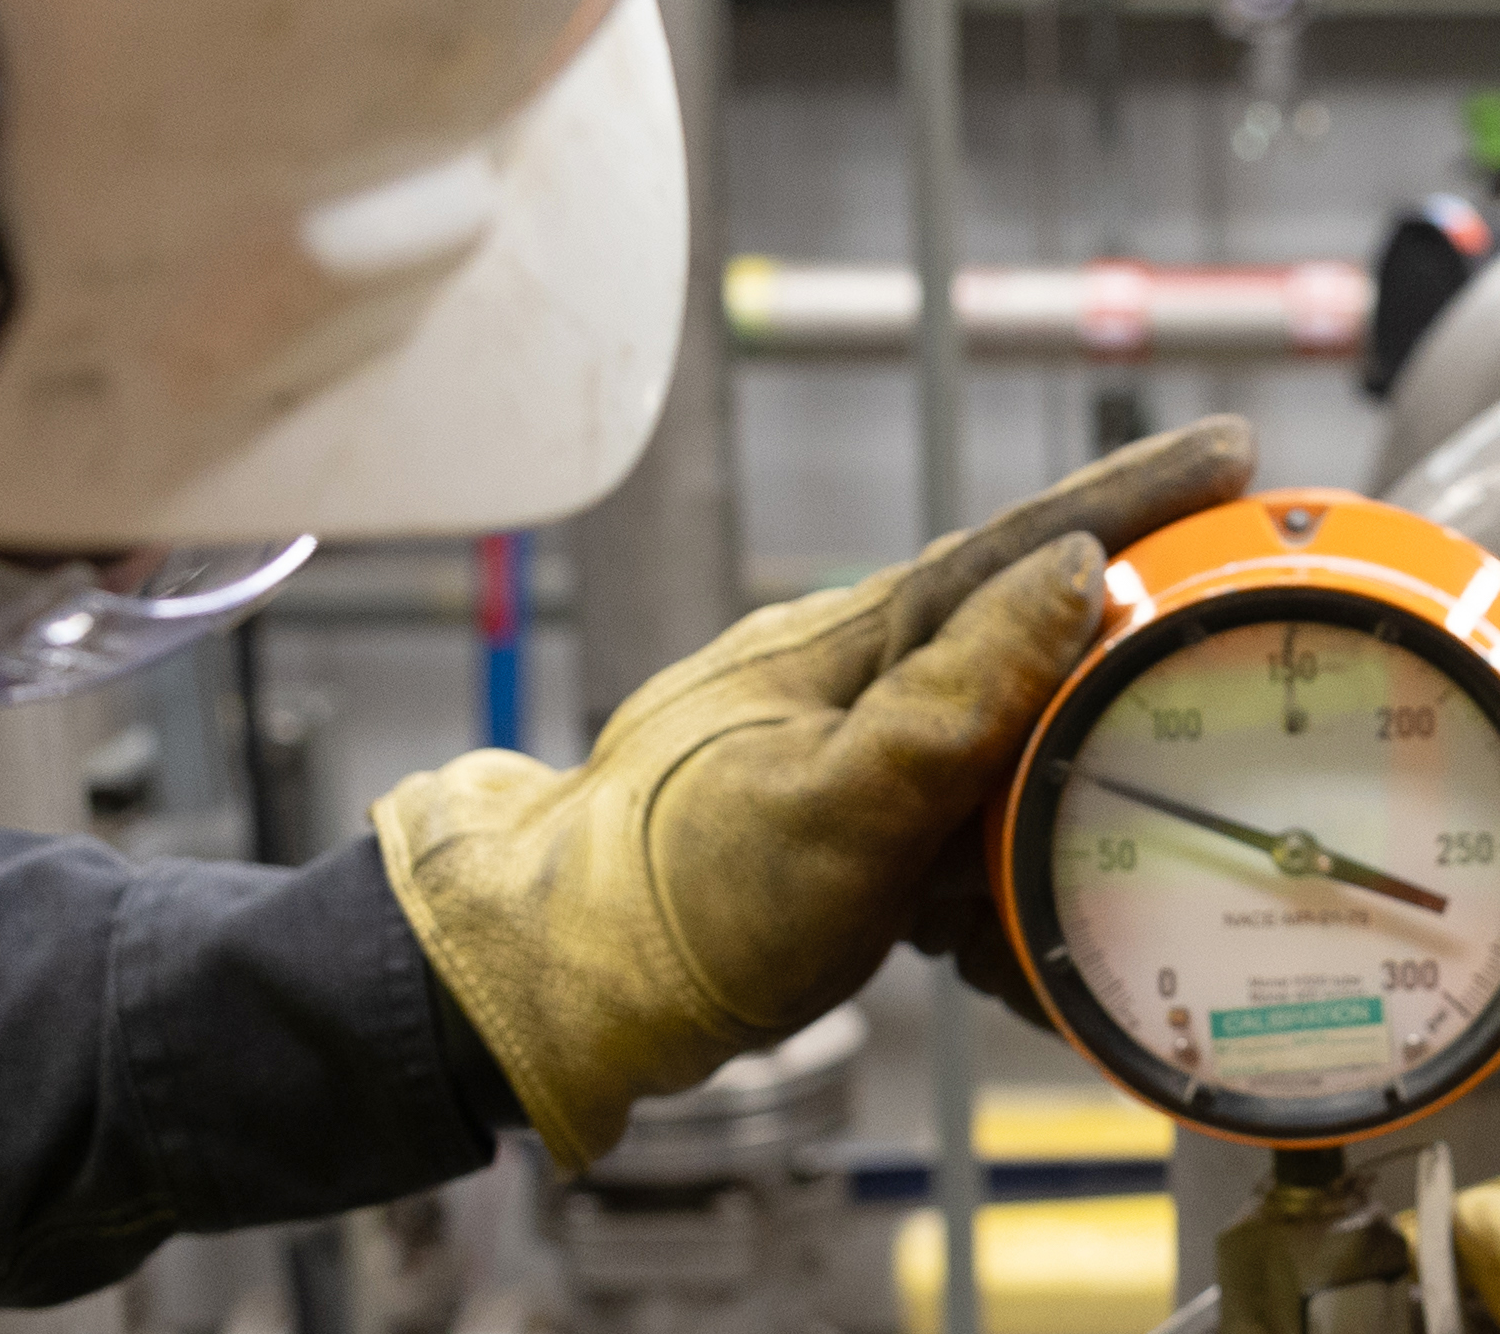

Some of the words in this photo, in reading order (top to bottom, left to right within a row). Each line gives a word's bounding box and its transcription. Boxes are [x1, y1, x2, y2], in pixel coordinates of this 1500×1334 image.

[1267, 649, 1320, 686] 150
[1151, 707, 1202, 742] 100
[1376, 705, 1436, 741] 200
[1097, 837, 1137, 873] 50
[1436, 831, 1495, 867] 250
[1157, 967, 1178, 1000] 0
[1380, 959, 1439, 993] 300
